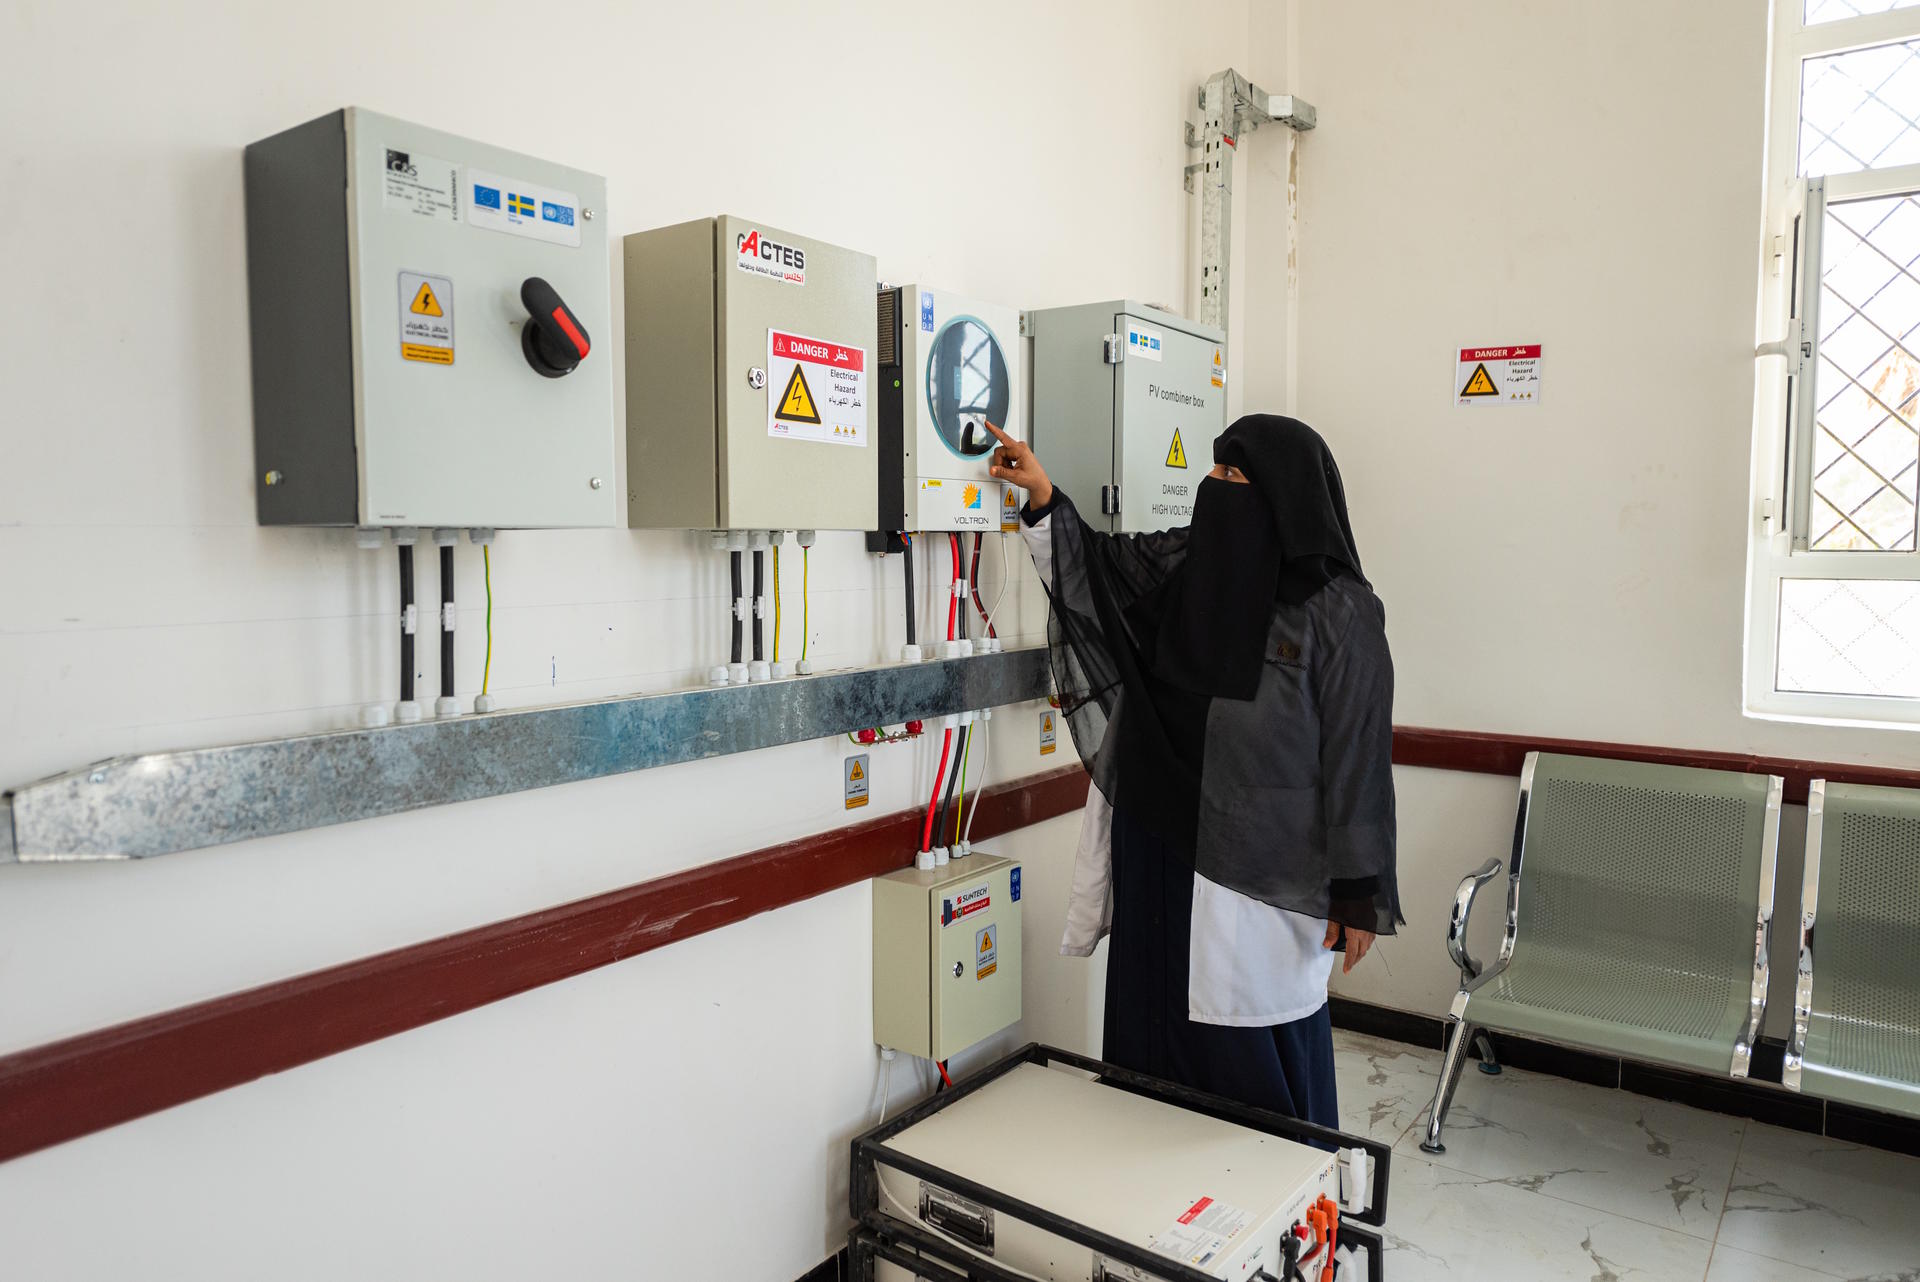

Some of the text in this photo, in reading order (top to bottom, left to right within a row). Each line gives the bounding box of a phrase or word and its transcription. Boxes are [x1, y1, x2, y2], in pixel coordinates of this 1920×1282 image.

[790, 340, 849, 362] DANGER خطر
[1475, 347, 1527, 358] DANGER خطر
[830, 368, 859, 382] Electrical
[834, 383, 856, 395] Hazard
[1149, 384, 1205, 408] PV combiner box
[1162, 484, 1189, 496] DANGER
[1152, 504, 1193, 517] HIGH VOLTAG
[954, 516, 990, 525] VOLTRON
[962, 887, 988, 903] SUNTECH
